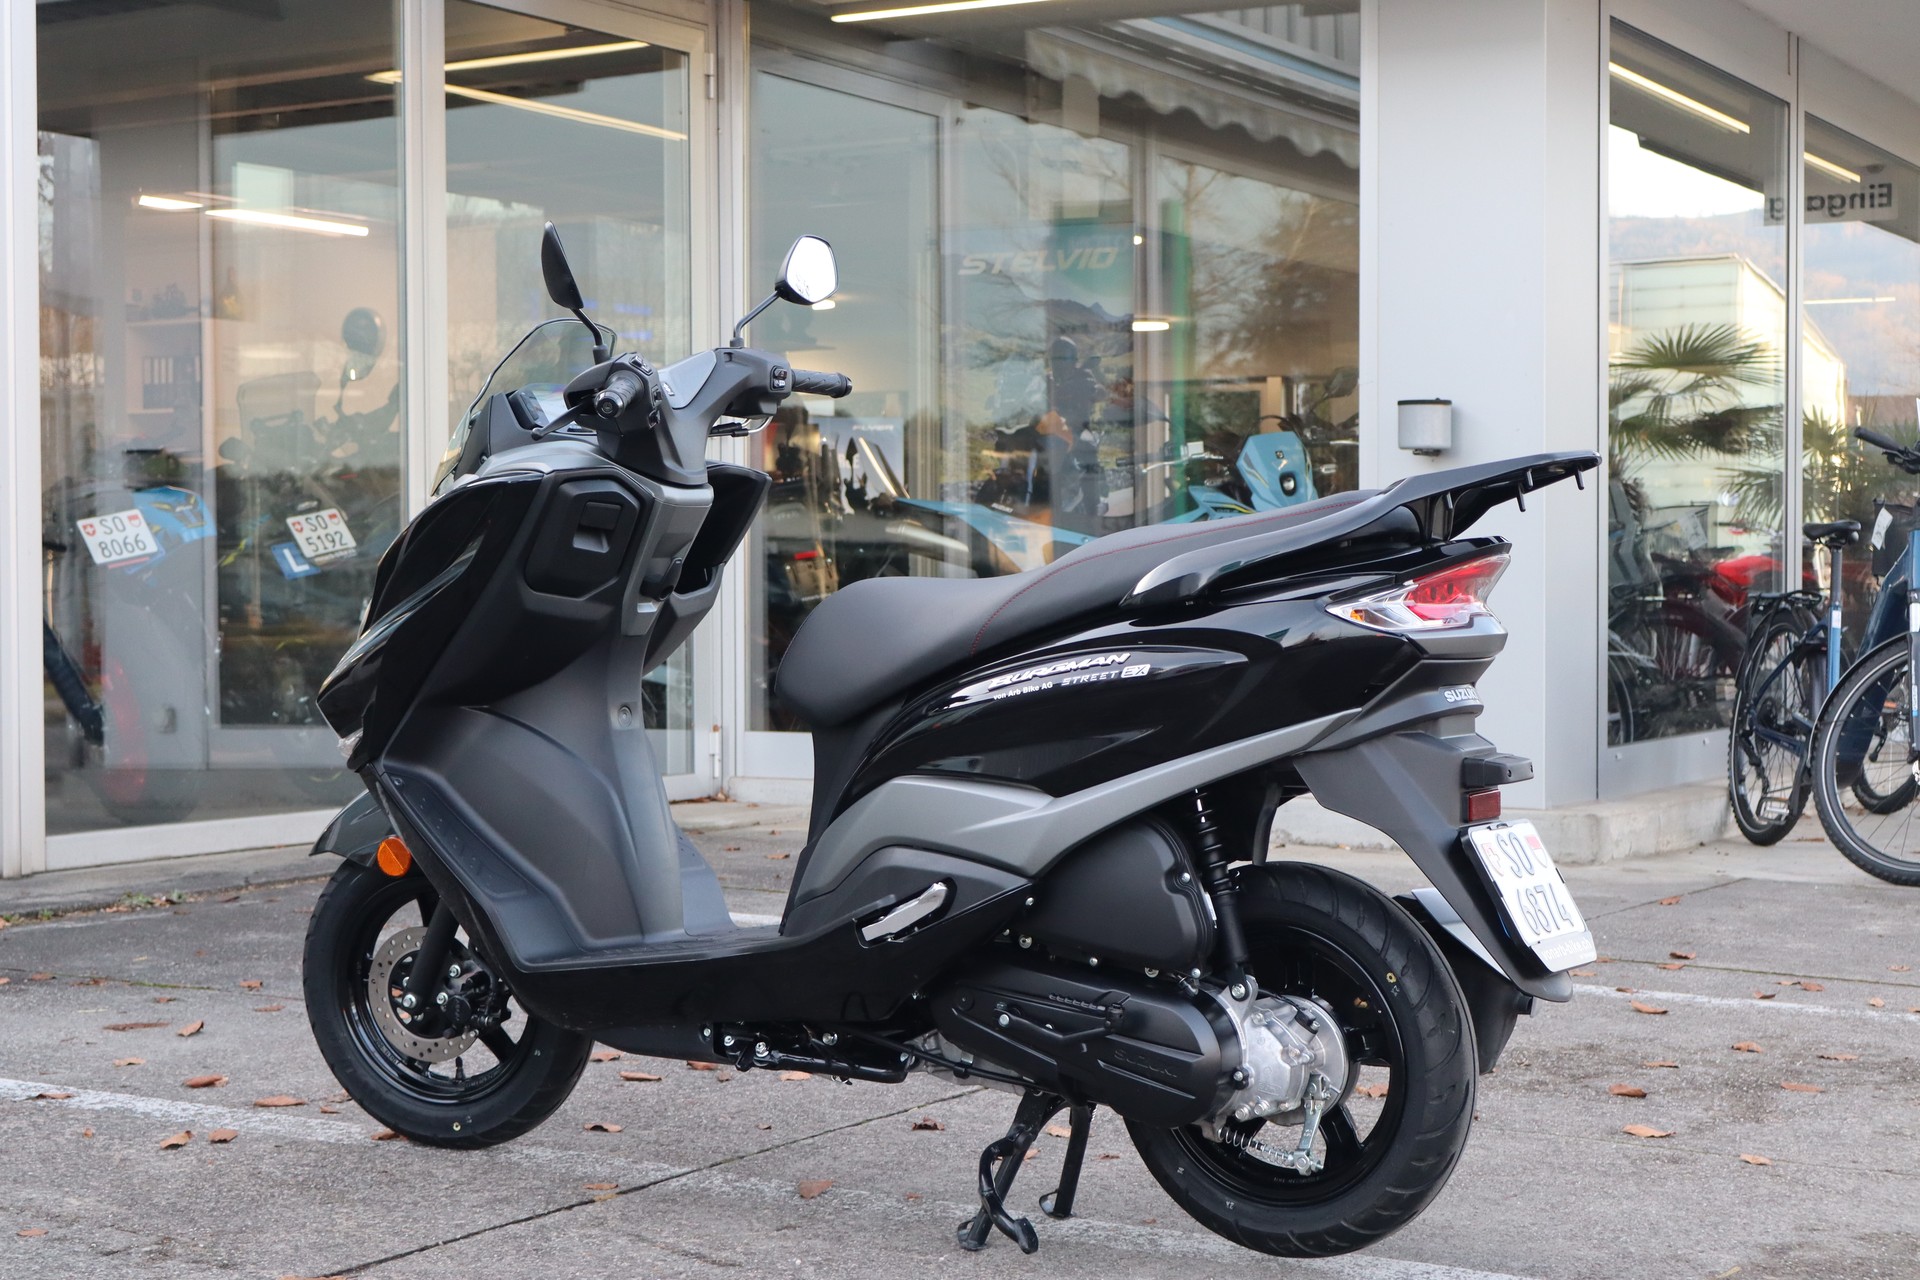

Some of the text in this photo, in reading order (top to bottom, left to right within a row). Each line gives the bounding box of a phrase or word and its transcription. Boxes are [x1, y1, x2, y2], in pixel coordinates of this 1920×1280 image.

[958, 247, 1118, 275] STELVIO
[99, 516, 126, 535] SO
[305, 514, 328, 532] SO
[98, 533, 147, 558] 8066
[305, 531, 348, 552] 5192
[283, 548, 310, 573] L
[988, 653, 1131, 692] BURGMAN
[1061, 664, 1150, 686] STREET EX
[993, 692, 1007, 700] von
[1008, 688, 1021, 697] Arb
[1022, 684, 1040, 694] Bike
[1496, 832, 1535, 878] SO
[1517, 883, 1575, 936] 6874
